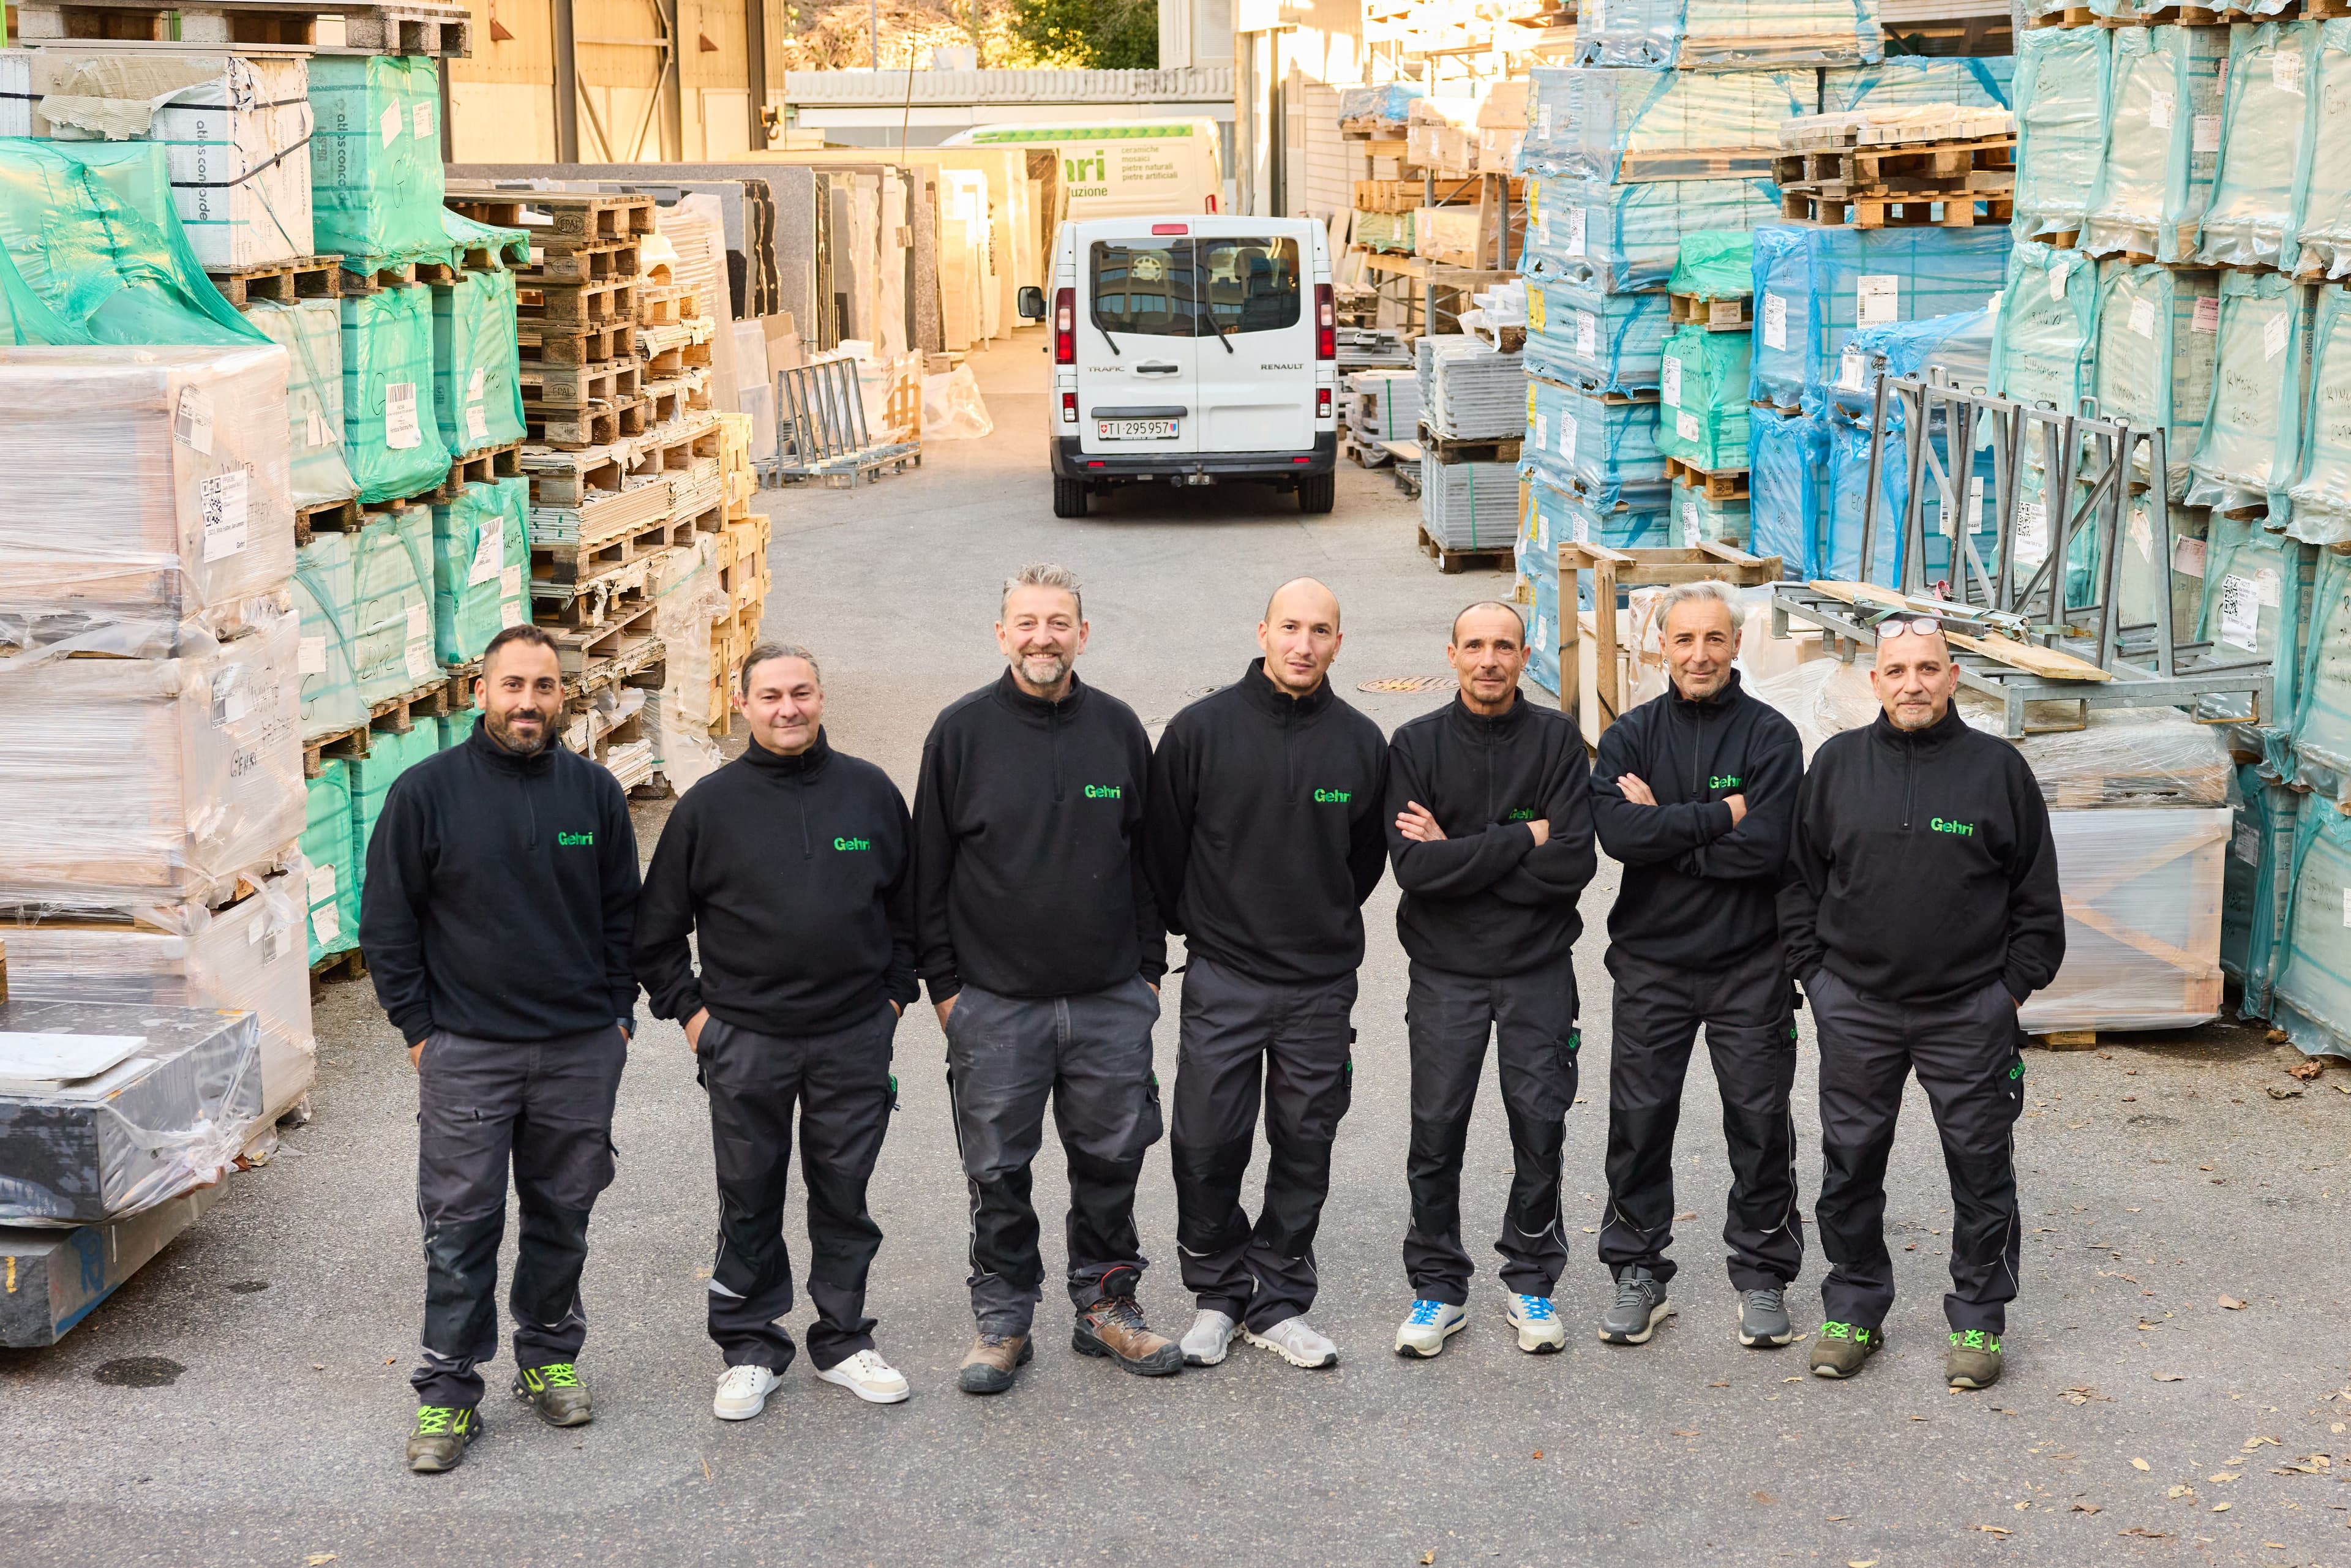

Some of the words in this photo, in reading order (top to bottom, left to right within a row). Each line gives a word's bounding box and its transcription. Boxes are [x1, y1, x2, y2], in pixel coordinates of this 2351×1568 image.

[197, 120, 208, 156] atls
[338, 150, 348, 207] concode
[1146, 171, 1178, 180] artificiali
[198, 157, 210, 220] conorde
[1085, 784, 1120, 799] Gehri
[1930, 817, 1974, 836] Gehri
[558, 831, 593, 846] Gehri
